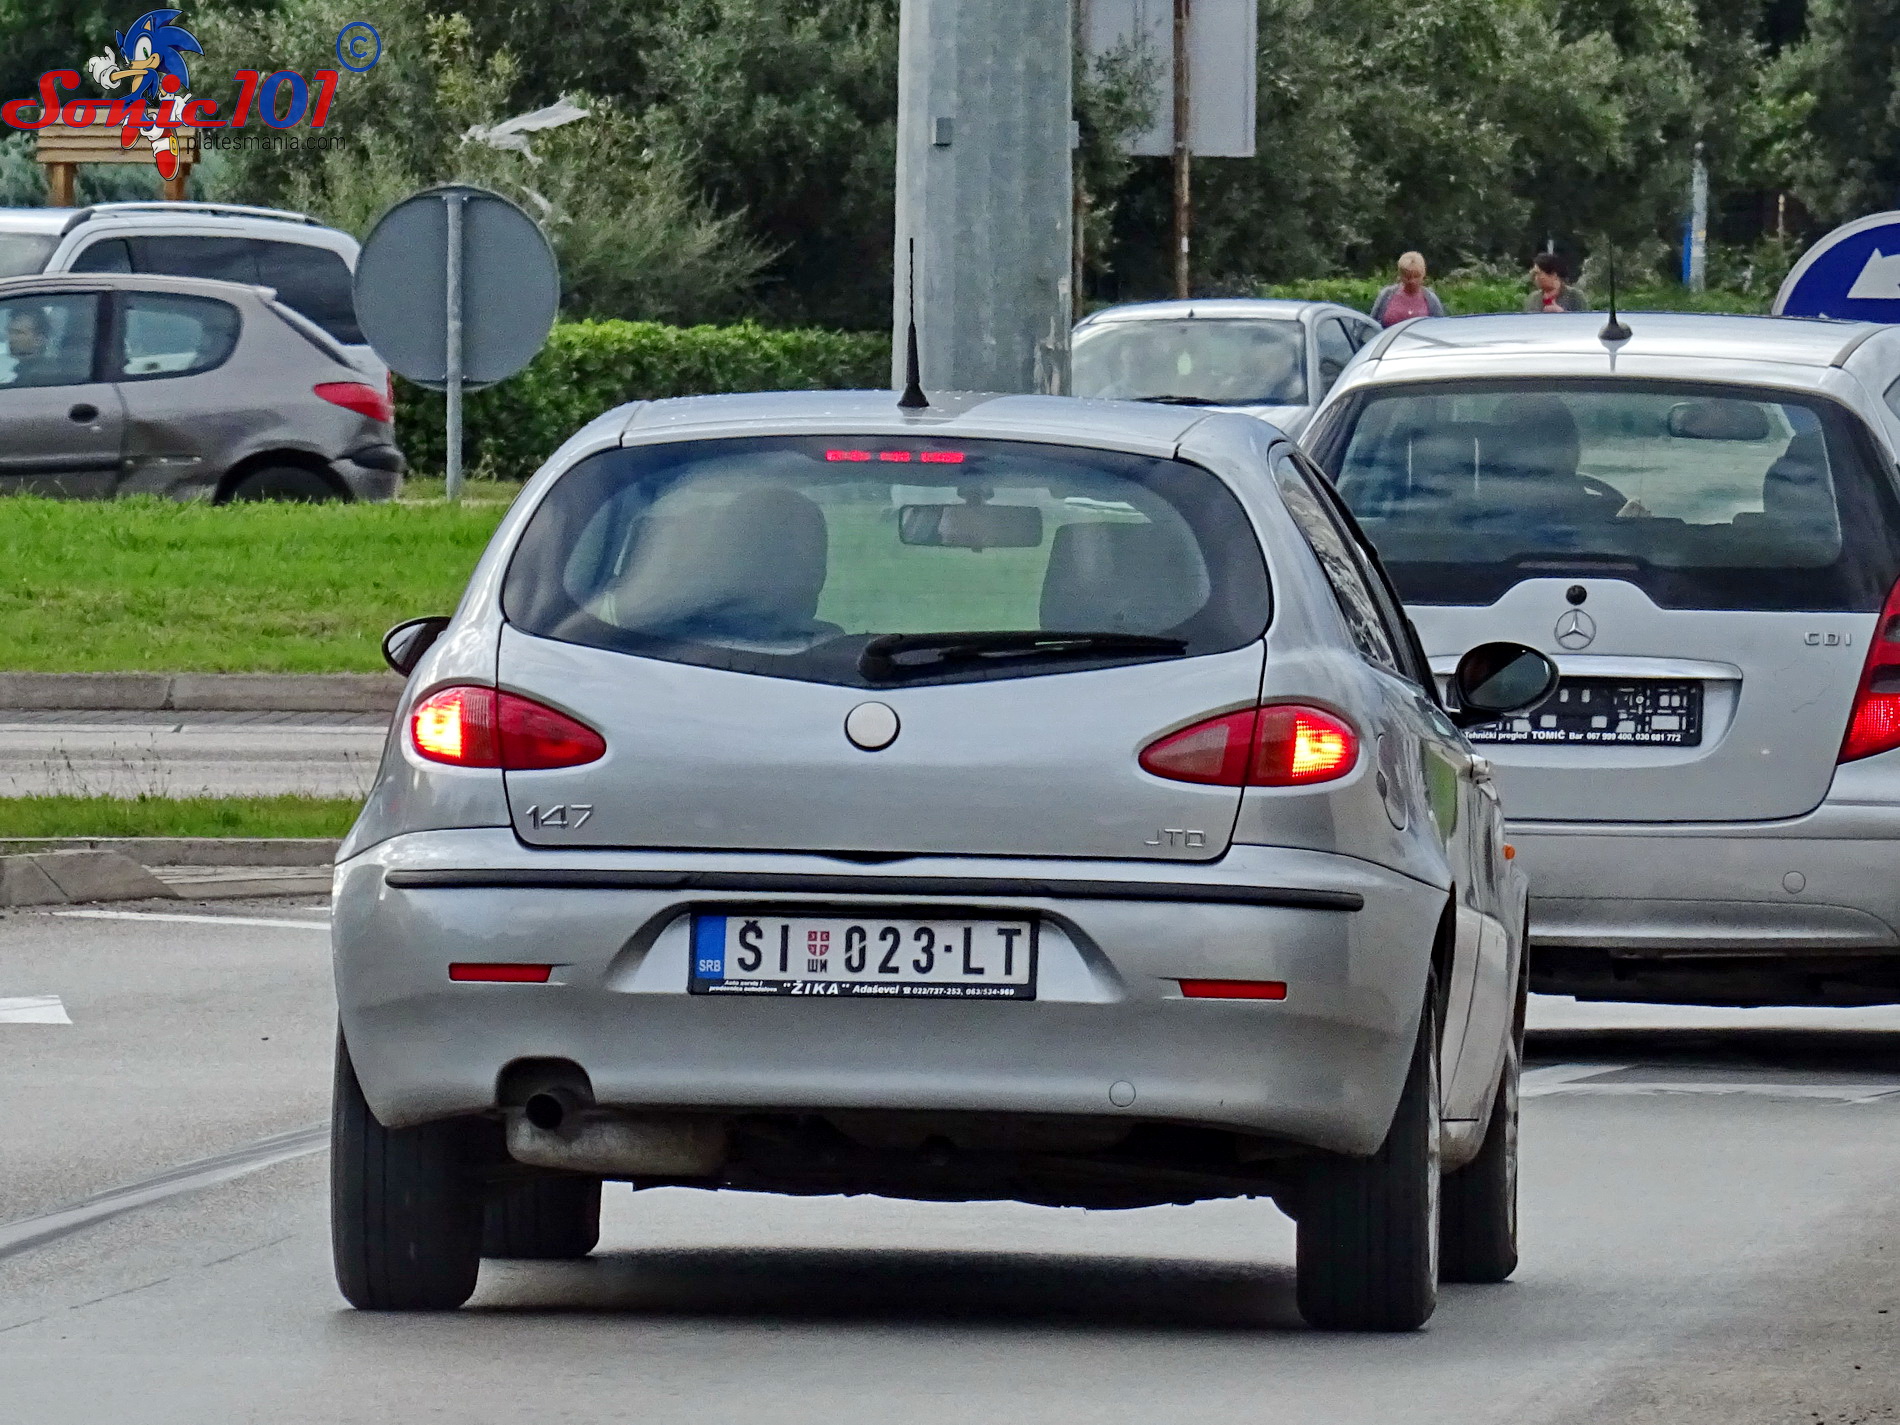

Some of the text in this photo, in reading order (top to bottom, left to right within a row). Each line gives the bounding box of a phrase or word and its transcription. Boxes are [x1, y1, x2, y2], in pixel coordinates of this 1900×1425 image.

[1804, 631, 1851, 647] CDI
[1498, 731, 1528, 741] pregled
[1531, 730, 1566, 740] TOMIĆ
[1568, 732, 1584, 740] Bar
[1635, 733, 1650, 741] 030
[1666, 734, 1681, 742] 772
[526, 804, 593, 830] 147
[1144, 828, 1206, 848] JTD
[737, 920, 790, 973] ŠI
[698, 959, 721, 972] SRB
